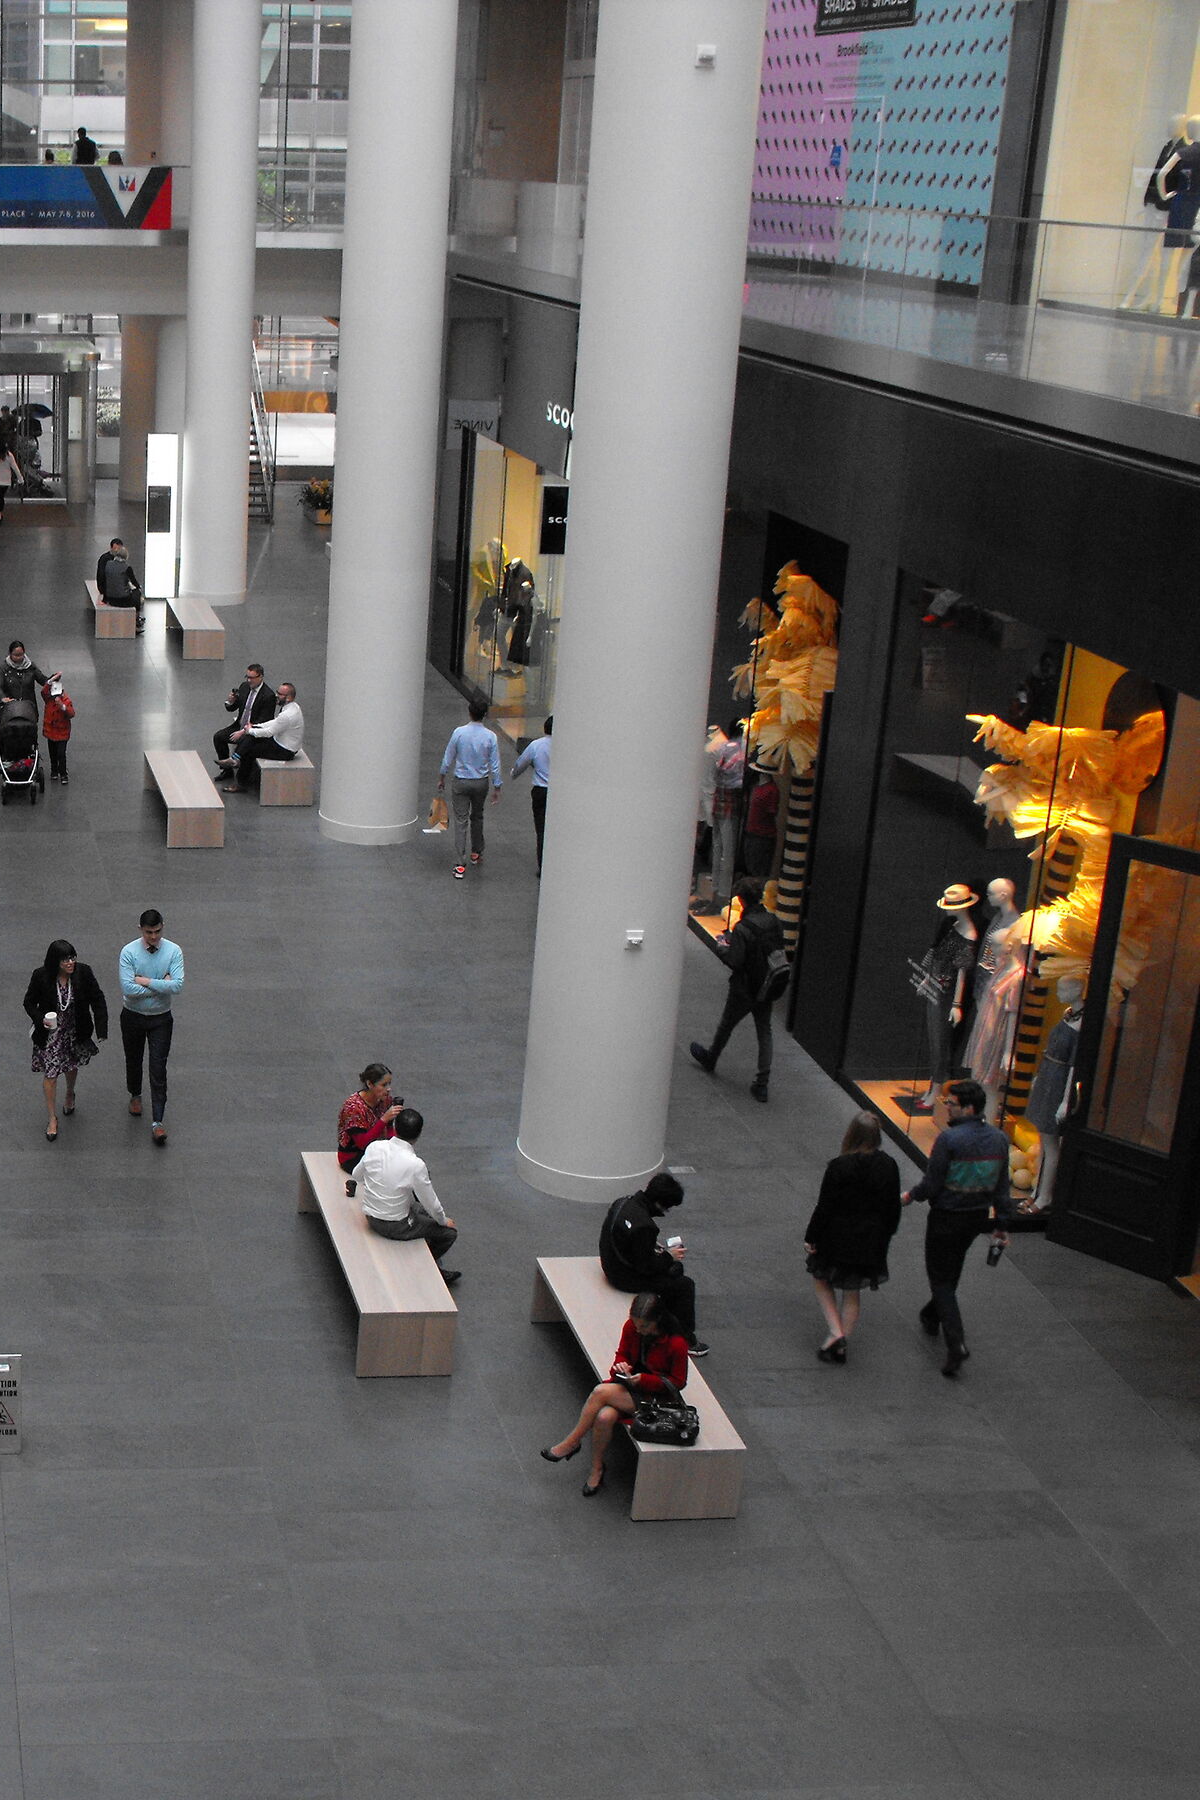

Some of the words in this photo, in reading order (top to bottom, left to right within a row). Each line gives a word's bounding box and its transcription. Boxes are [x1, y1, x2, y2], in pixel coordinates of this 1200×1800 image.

[824, 0, 856, 14] SHADES
[837, 43, 868, 57] Brookfield
[1, 210, 26, 218] PLACE
[38, 210, 56, 218] MAY
[76, 210, 96, 218] 2016
